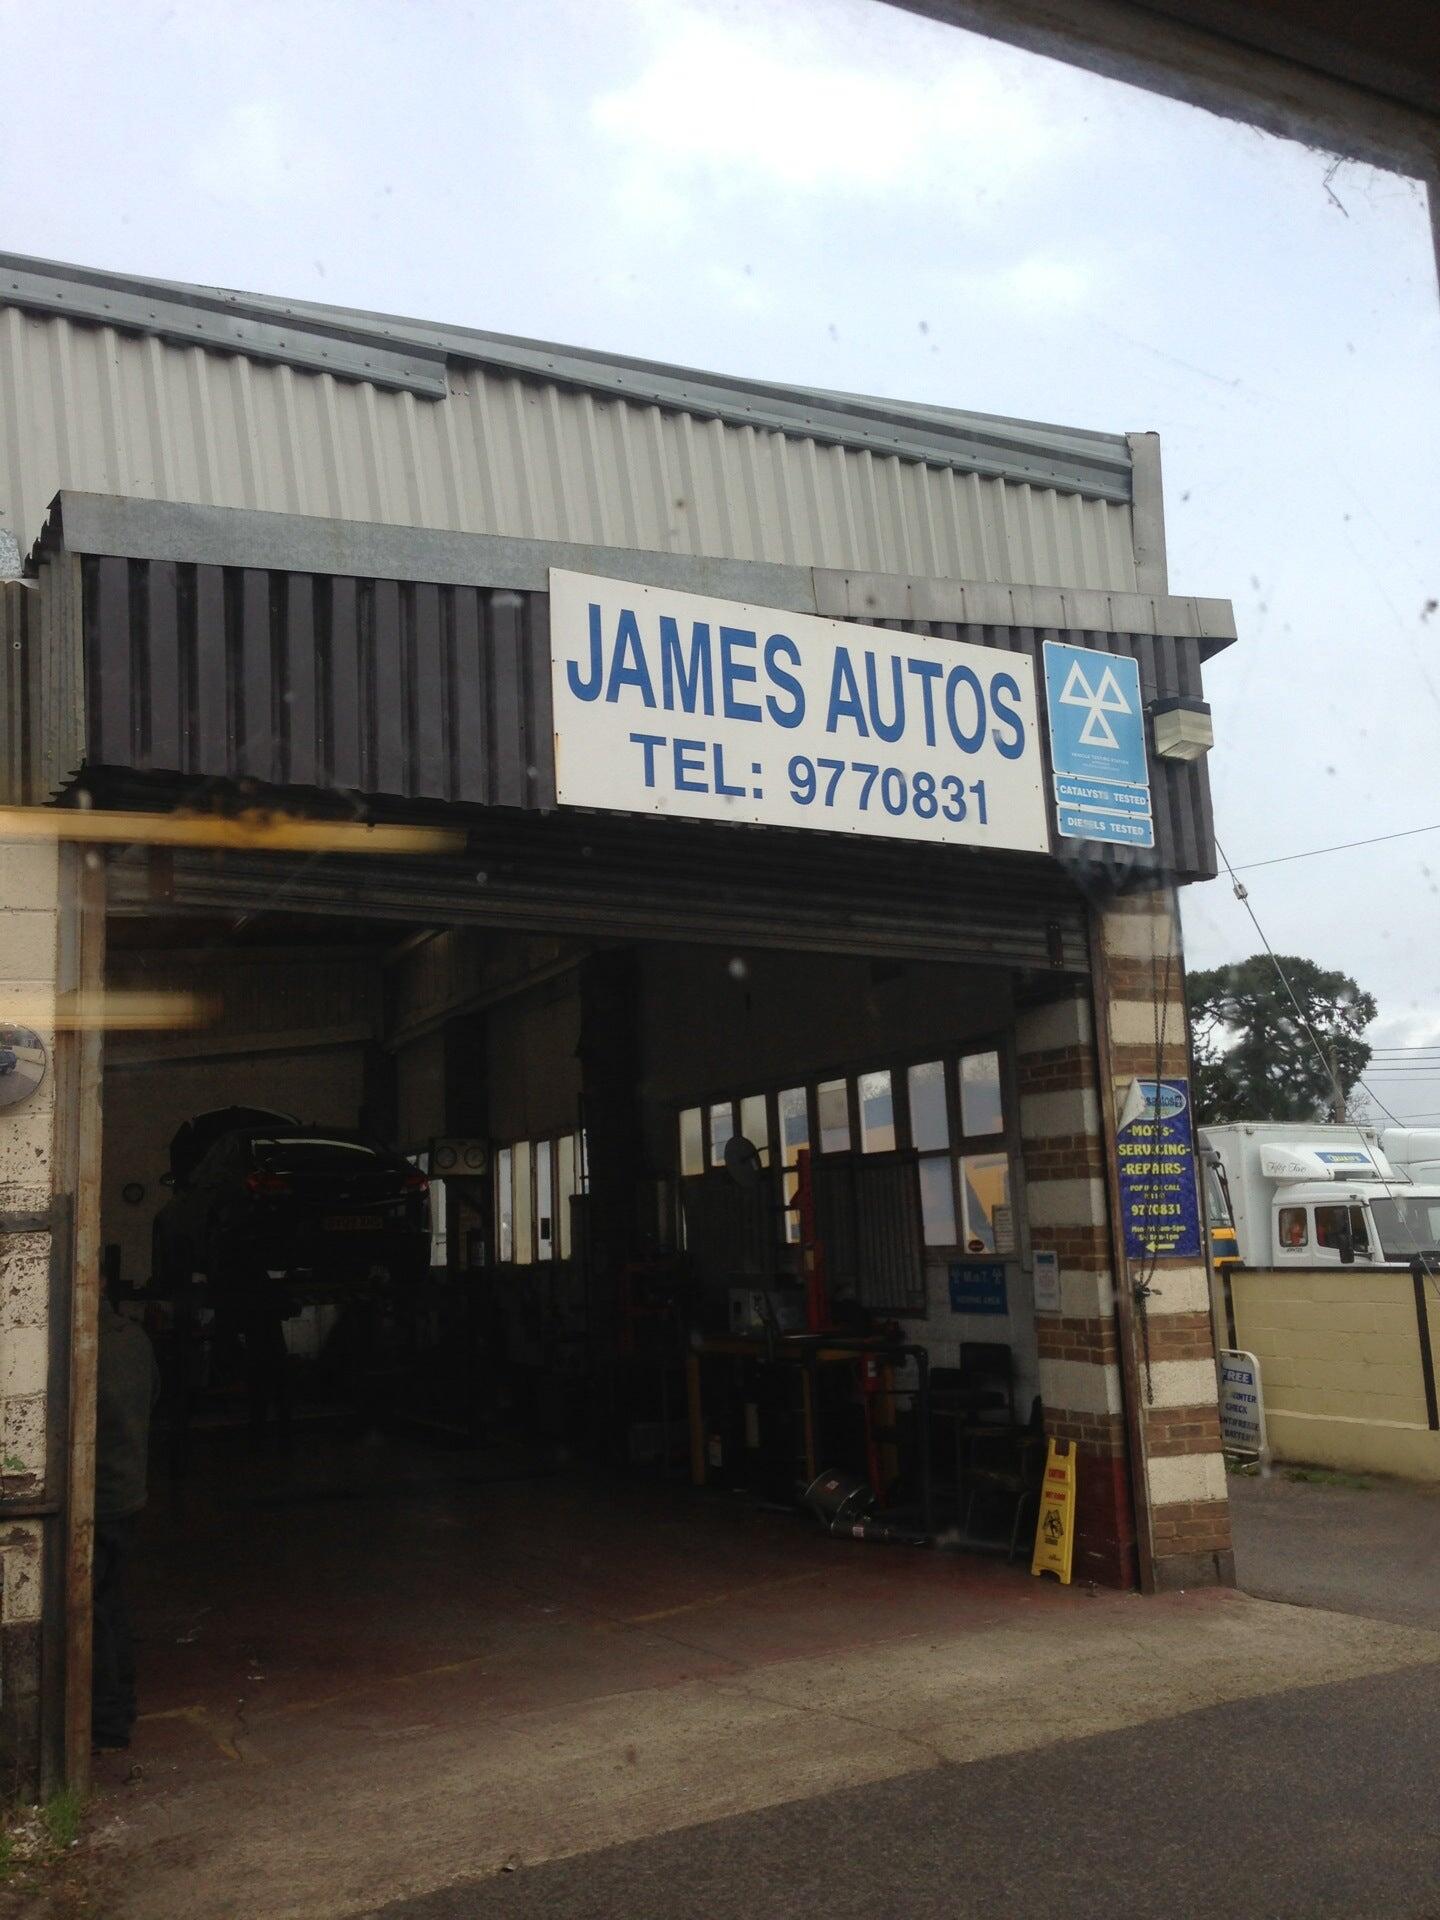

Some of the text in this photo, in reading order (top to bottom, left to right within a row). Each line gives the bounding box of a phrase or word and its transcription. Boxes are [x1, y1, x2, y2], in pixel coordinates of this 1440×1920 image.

[566, 603, 1026, 760] JAMES AUTOS
[630, 733, 988, 825] TEL: 9770831
[1113, 793, 1146, 805] TESTED
[1067, 817, 1144, 836] DIELS TESTED
